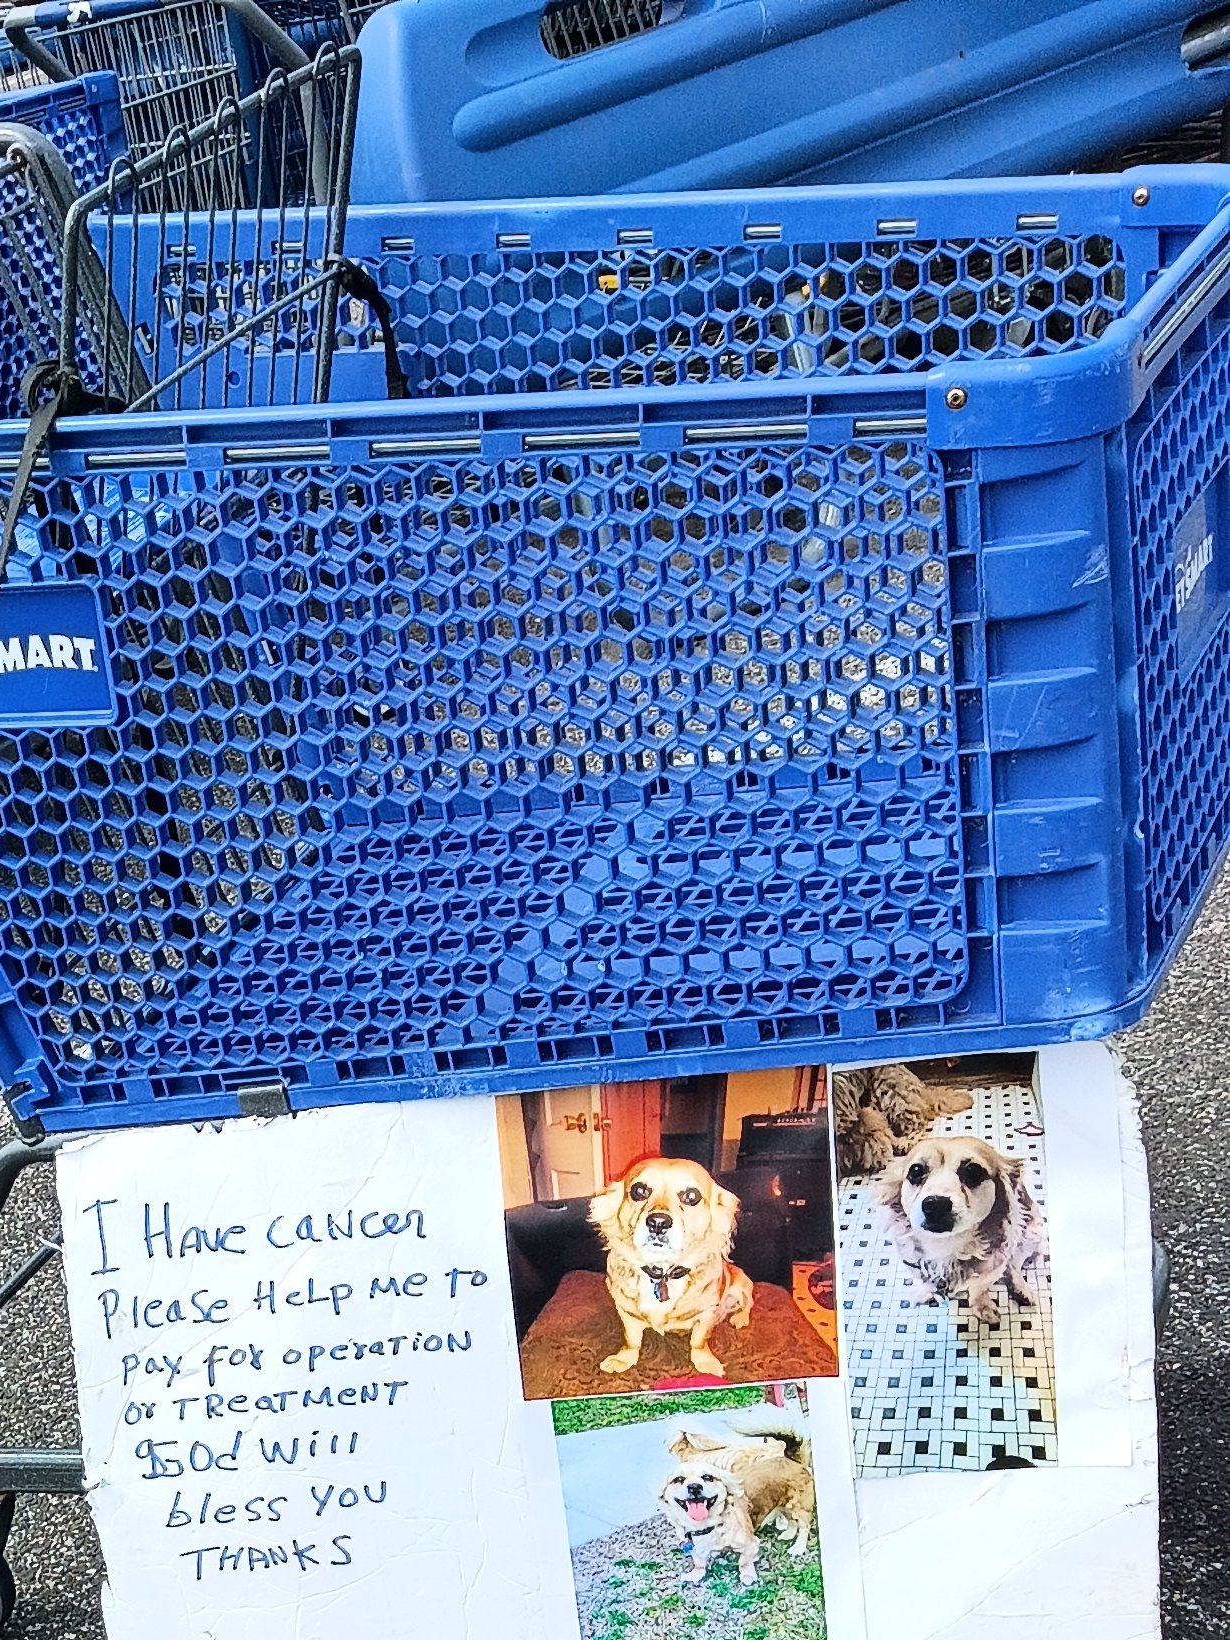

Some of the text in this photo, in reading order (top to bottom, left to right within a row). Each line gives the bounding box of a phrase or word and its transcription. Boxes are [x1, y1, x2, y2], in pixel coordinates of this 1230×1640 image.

[1174, 534, 1214, 615] ETSMART
[82, 1198, 120, 1275] I
[179, 1533, 355, 1582] THANKS
